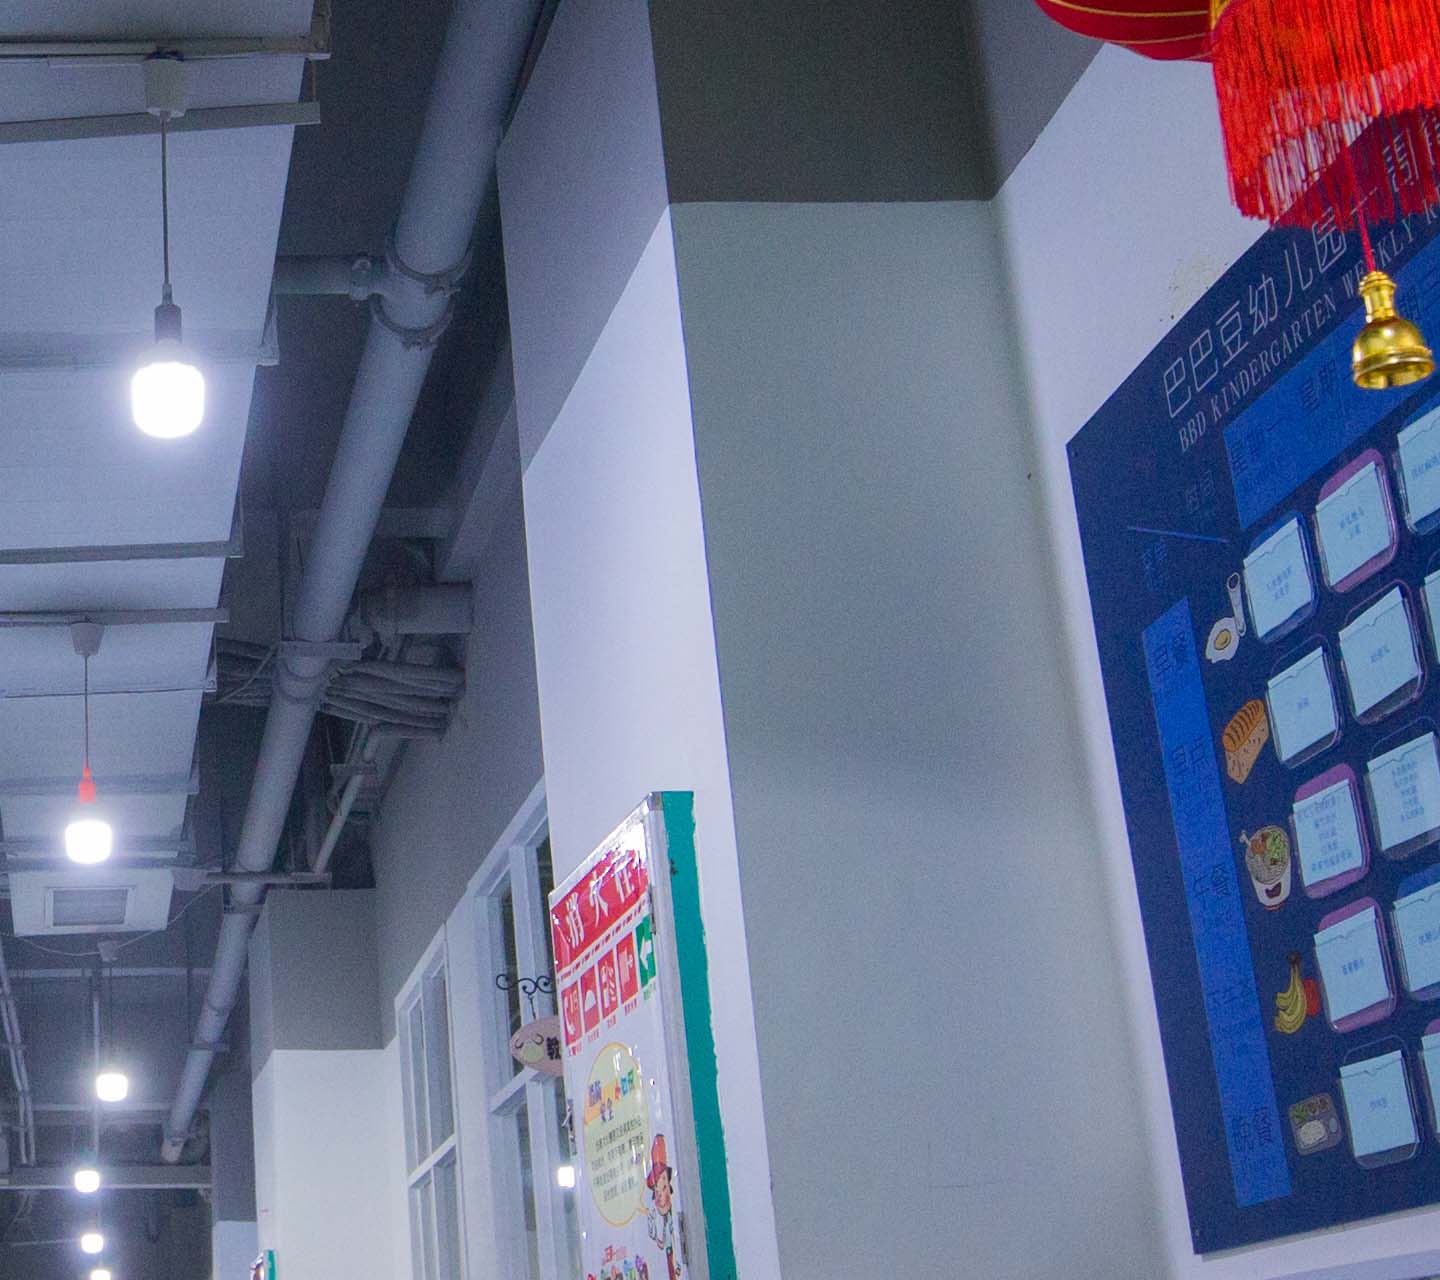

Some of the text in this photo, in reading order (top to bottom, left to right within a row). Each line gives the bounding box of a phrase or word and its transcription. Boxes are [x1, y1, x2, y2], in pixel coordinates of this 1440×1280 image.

[1178, 410, 1207, 453] BBD
[1211, 290, 1338, 423] KINDERGARTEN
[1341, 213, 1415, 299] WEKLY
